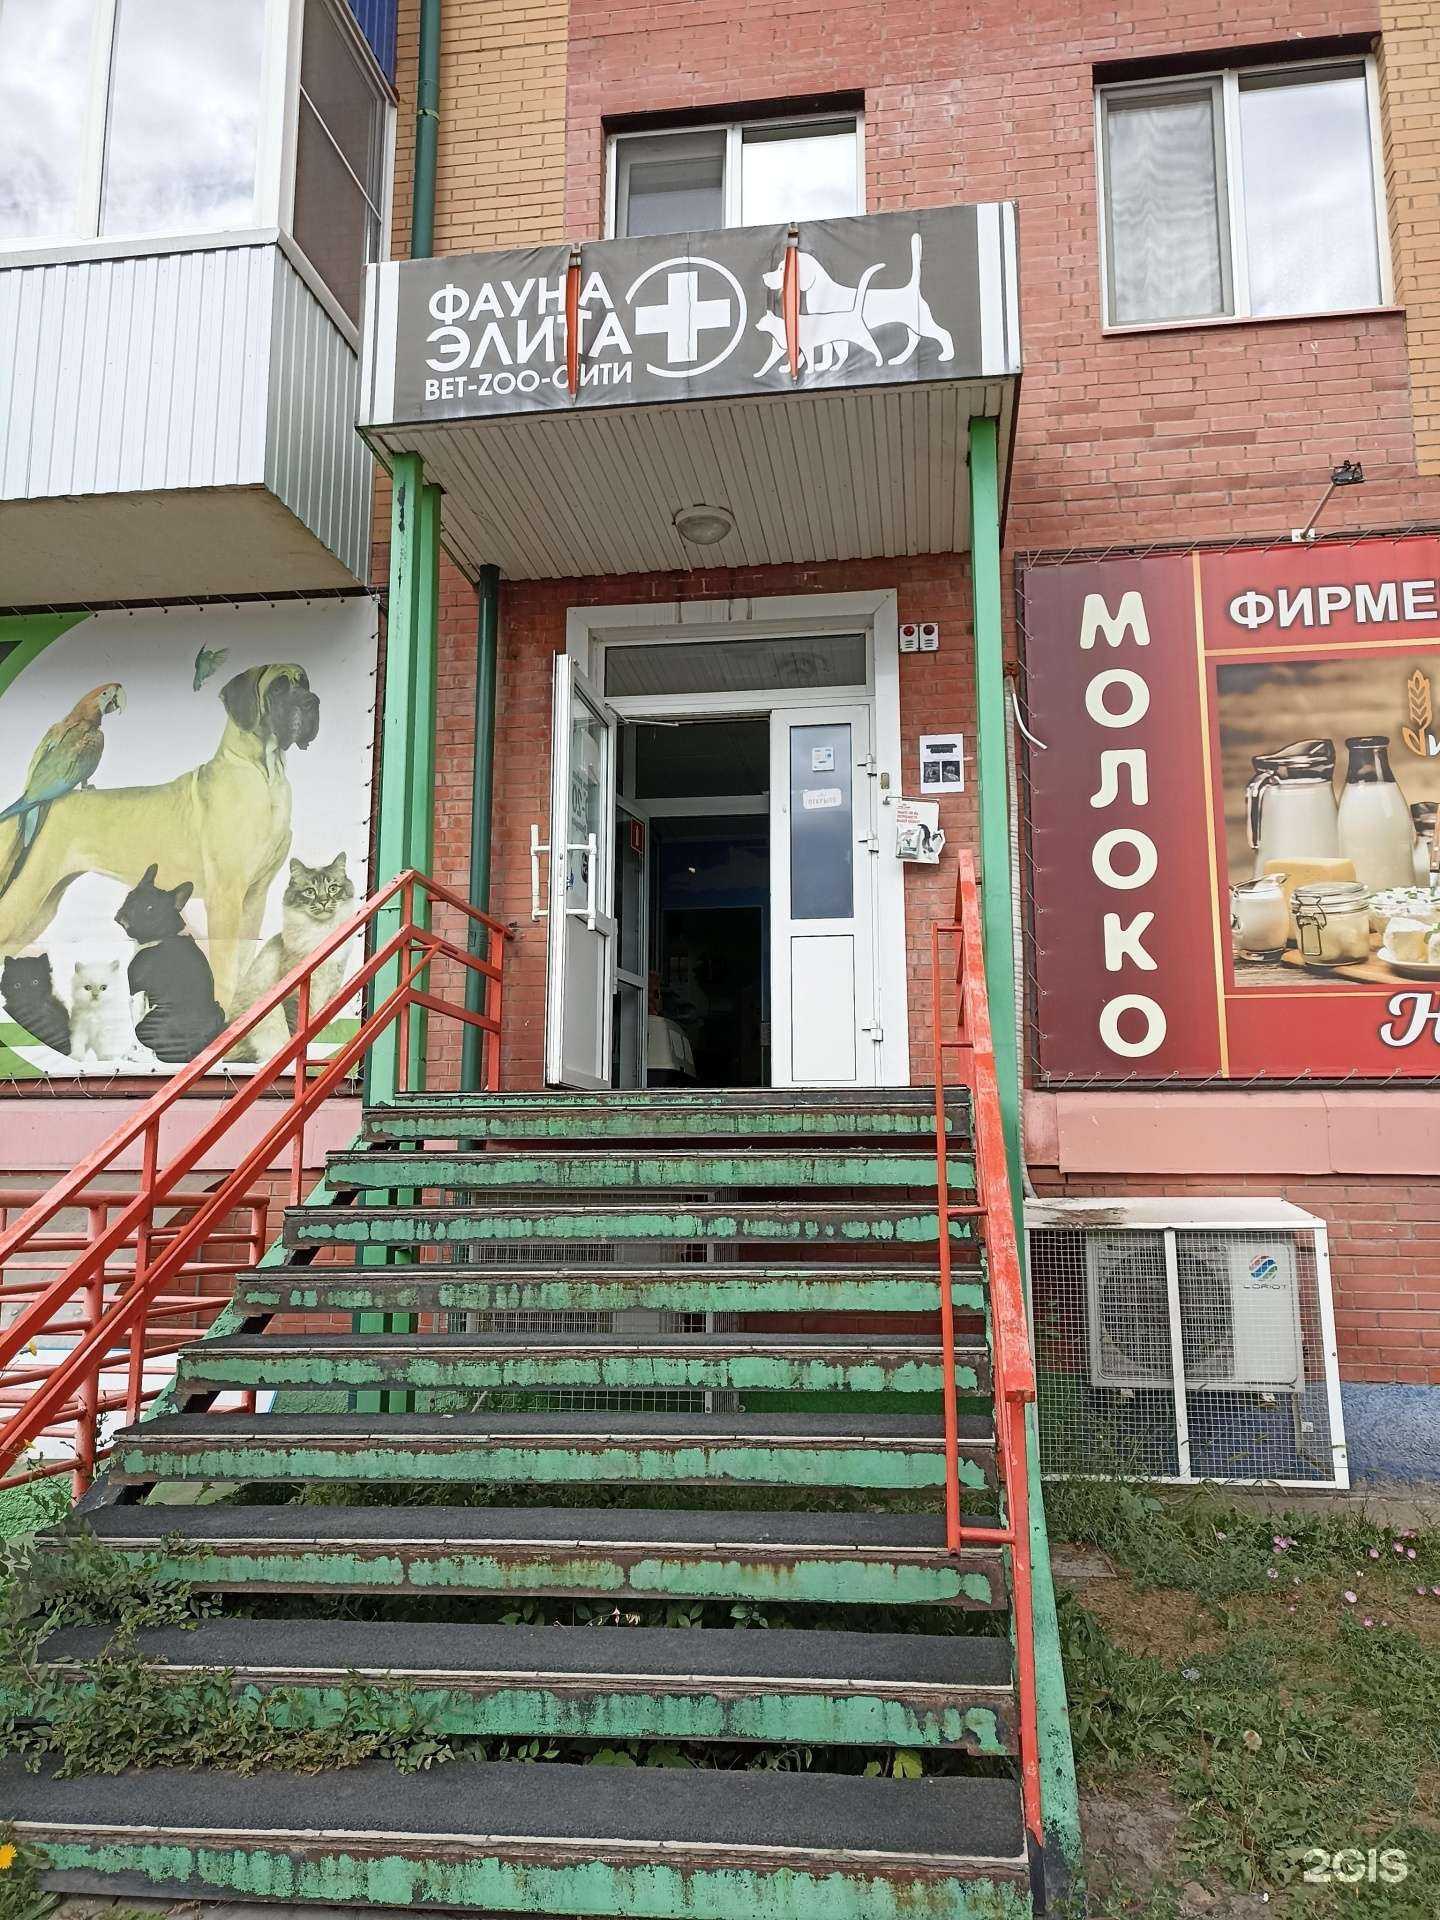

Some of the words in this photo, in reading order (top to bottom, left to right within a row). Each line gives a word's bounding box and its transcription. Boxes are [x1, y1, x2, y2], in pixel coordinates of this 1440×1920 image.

[428, 271, 615, 325] ФАУНА
[424, 311, 633, 372] ЭЛИТА
[1079, 591, 1168, 1058] МОЛОКО
